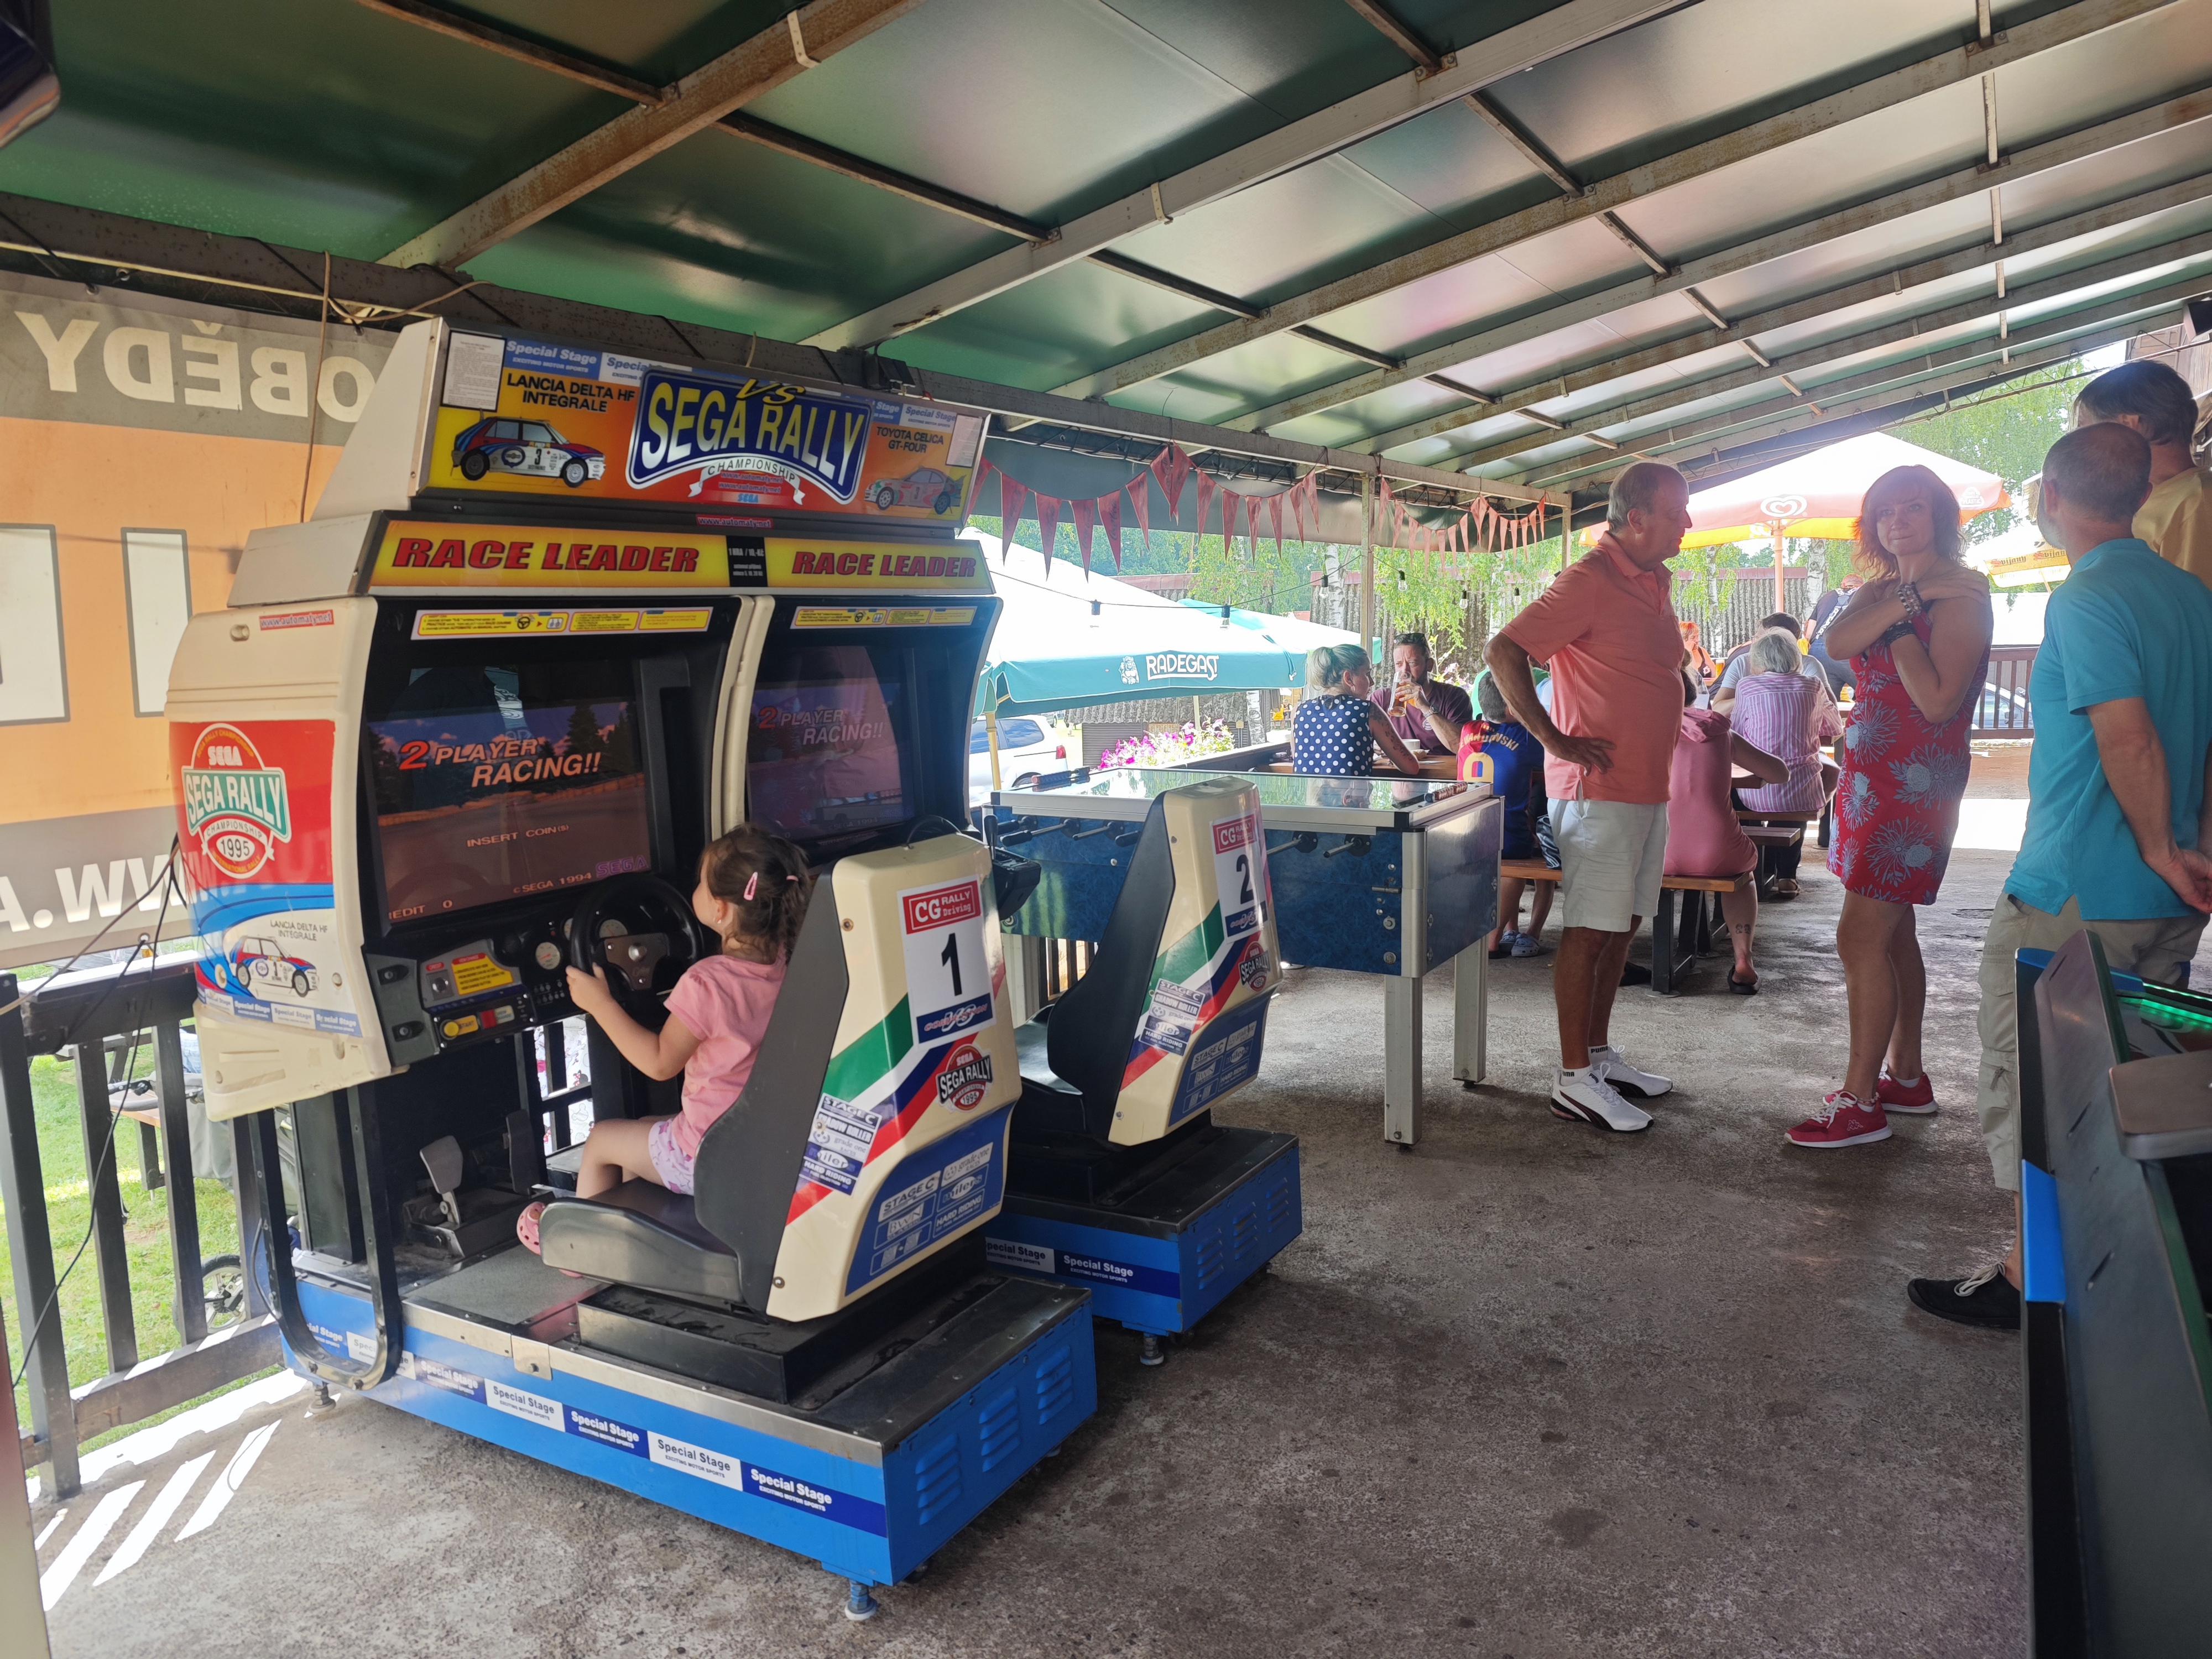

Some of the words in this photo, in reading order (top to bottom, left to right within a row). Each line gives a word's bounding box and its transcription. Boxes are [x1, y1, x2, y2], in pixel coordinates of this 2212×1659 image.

[507, 341, 557, 357] Special
[560, 349, 597, 365] Stage
[507, 373, 566, 393] LANCIA
[570, 382, 613, 399] DELTA
[618, 389, 635, 401] HF
[523, 390, 607, 412] INTEGRALE
[877, 401, 900, 413] Stage
[906, 406, 933, 418] Special
[936, 411, 956, 421] Stage
[642, 382, 747, 469] SEGA
[755, 404, 864, 486] RALLY
[877, 427, 911, 440] TOYOTA
[914, 432, 943, 445] CELICA
[534, 449, 542, 465] 3
[888, 440, 927, 453] GT-FOUR
[708, 459, 795, 482] CHAMPIONSHIP
[698, 517, 771, 529] www.automaty.net
[392, 538, 534, 570] RACE
[541, 543, 699, 572] LEADER
[792, 551, 875, 576] RACE
[879, 555, 976, 577] LEADER
[2033, 550, 2067, 561] Svijan
[1145, 654, 1219, 681] RADEGAST
[759, 707, 778, 729] 2
[781, 709, 844, 726] PLAYER
[803, 722, 883, 745] RACING!!
[208, 746, 242, 766] SEGA
[399, 740, 430, 770] 2
[435, 739, 538, 765] PLAYER
[471, 752, 601, 787] RACING!!
[185, 775, 225, 824] SEGA
[226, 776, 281, 830] RALLY
[206, 821, 263, 839] CHAMPIONSHIP
[467, 832, 519, 848] INSERT
[1220, 827, 1237, 846] CG
[221, 838, 251, 858] 1995
[596, 855, 648, 879] SEGA
[559, 872, 592, 885] 1994
[1236, 854, 1254, 905] 2
[915, 899, 942, 923] CG
[942, 891, 971, 905] RALLY
[943, 904, 972, 916] Driving
[270, 919, 296, 929] LANCIA
[297, 922, 318, 932] DELTA
[941, 932, 963, 997] 1
[1241, 961, 1256, 982] SEGA
[1160, 981, 1193, 996] STAGE
[1145, 1031, 1162, 1040] HARD
[1162, 1036, 1183, 1048] RIDING
[956, 1052, 973, 1066] SEGA
[1194, 1048, 1217, 1063] STAGE
[940, 1070, 965, 1099] SEGA
[966, 1058, 990, 1081] RALLY
[963, 1092, 977, 1104] 1995
[824, 1096, 865, 1118] STAGE
[865, 1114, 877, 1124] C
[805, 1161, 825, 1173] HARD
[826, 1170, 852, 1185] RIDING
[884, 1186, 924, 1212] STAGE
[925, 1178, 936, 1190] C
[936, 1209, 957, 1227] HARD
[958, 1195, 982, 1213] RIDING
[987, 1243, 1015, 1254] pecial
[1018, 1246, 1045, 1259] Stage
[1063, 1255, 1101, 1270] Special
[1103, 1262, 1134, 1277] Stage
[1071, 1267, 1091, 1276] EXCITING
[1109, 1275, 1128, 1283] SPORTS
[320, 1327, 343, 1342] Stage
[493, 1386, 526, 1405] Special
[528, 1397, 555, 1414] Stage
[571, 1411, 608, 1432] Special
[609, 1423, 639, 1442] Stage
[658, 1439, 696, 1460] Special
[700, 1452, 731, 1471] Stage
[665, 1454, 687, 1466] EXCITING
[688, 1463, 705, 1472] MOTOR
[706, 1468, 726, 1478] SPORTS
[751, 1468, 795, 1493] Special
[796, 1483, 832, 1504] Stage
